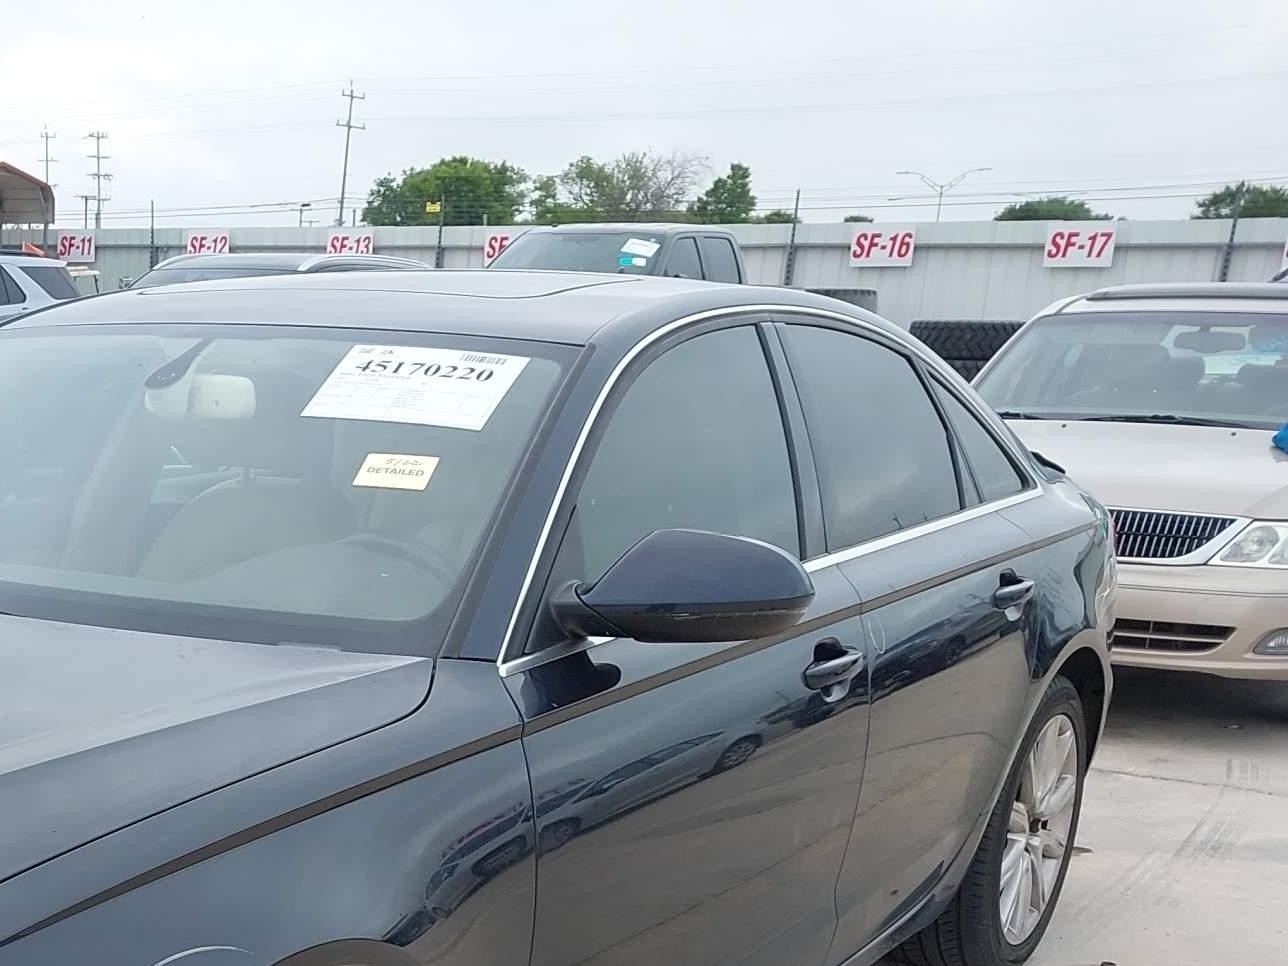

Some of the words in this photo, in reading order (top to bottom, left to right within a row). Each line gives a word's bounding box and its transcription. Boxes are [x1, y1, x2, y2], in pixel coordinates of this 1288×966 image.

[59, 235, 93, 257] SF-11
[189, 235, 228, 254] SF-12
[328, 235, 372, 254] SF-13
[851, 232, 913, 260] SF-16
[1045, 231, 1113, 259] SF-17
[356, 359, 495, 382] 45170220
[366, 466, 425, 477] DETAILED
